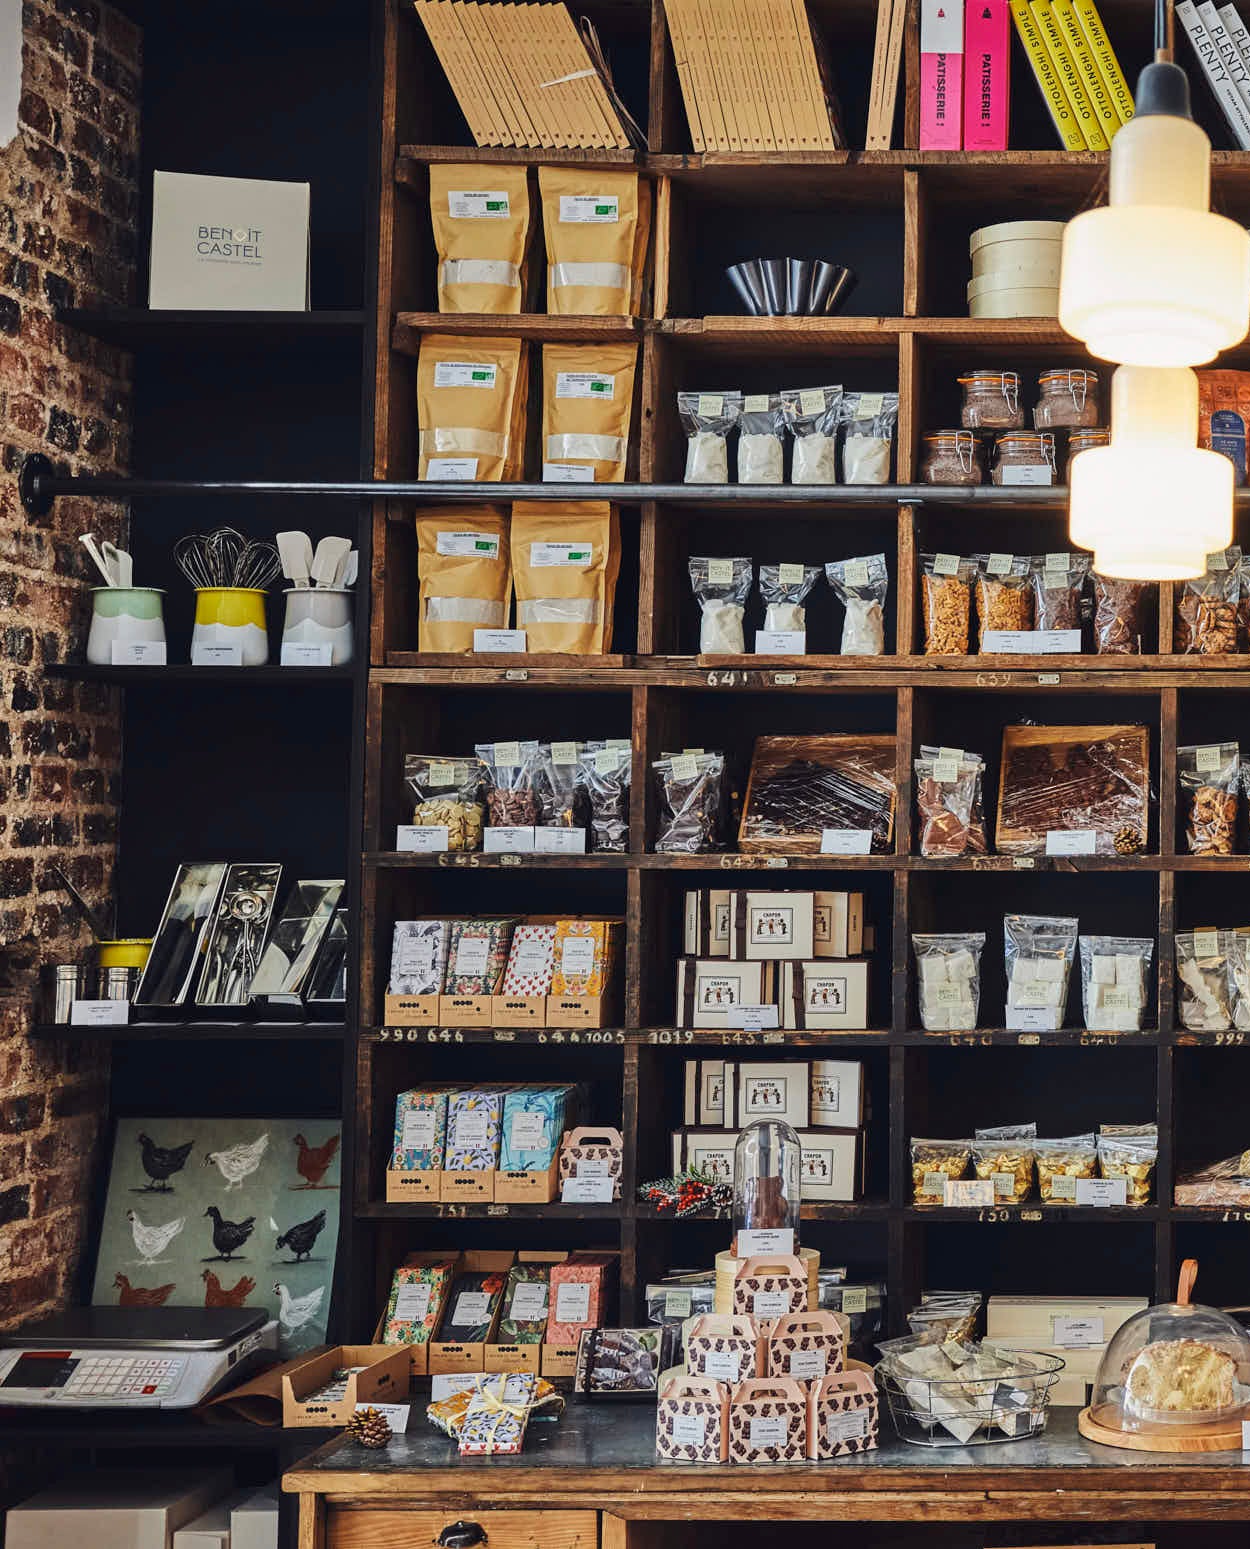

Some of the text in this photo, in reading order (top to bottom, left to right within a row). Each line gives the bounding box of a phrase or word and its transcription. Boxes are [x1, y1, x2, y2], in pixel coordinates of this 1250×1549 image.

[936, 53, 946, 119] PATISSERIE
[1019, 10, 1069, 119] OTTOLENGHI SIMPLE
[1041, 10, 1091, 119] OTTOLENGHI SIMPLE
[1062, 10, 1112, 119] OTTOLENGHI SIMPLE
[1084, 10, 1133, 119] OTTOLENGHI SIMPLE
[1190, 25, 1230, 82] PLENTY
[1210, 25, 1250, 82] PLENTY
[981, 54, 991, 120] PATISSERIE
[197, 242, 262, 258] CASTEL
